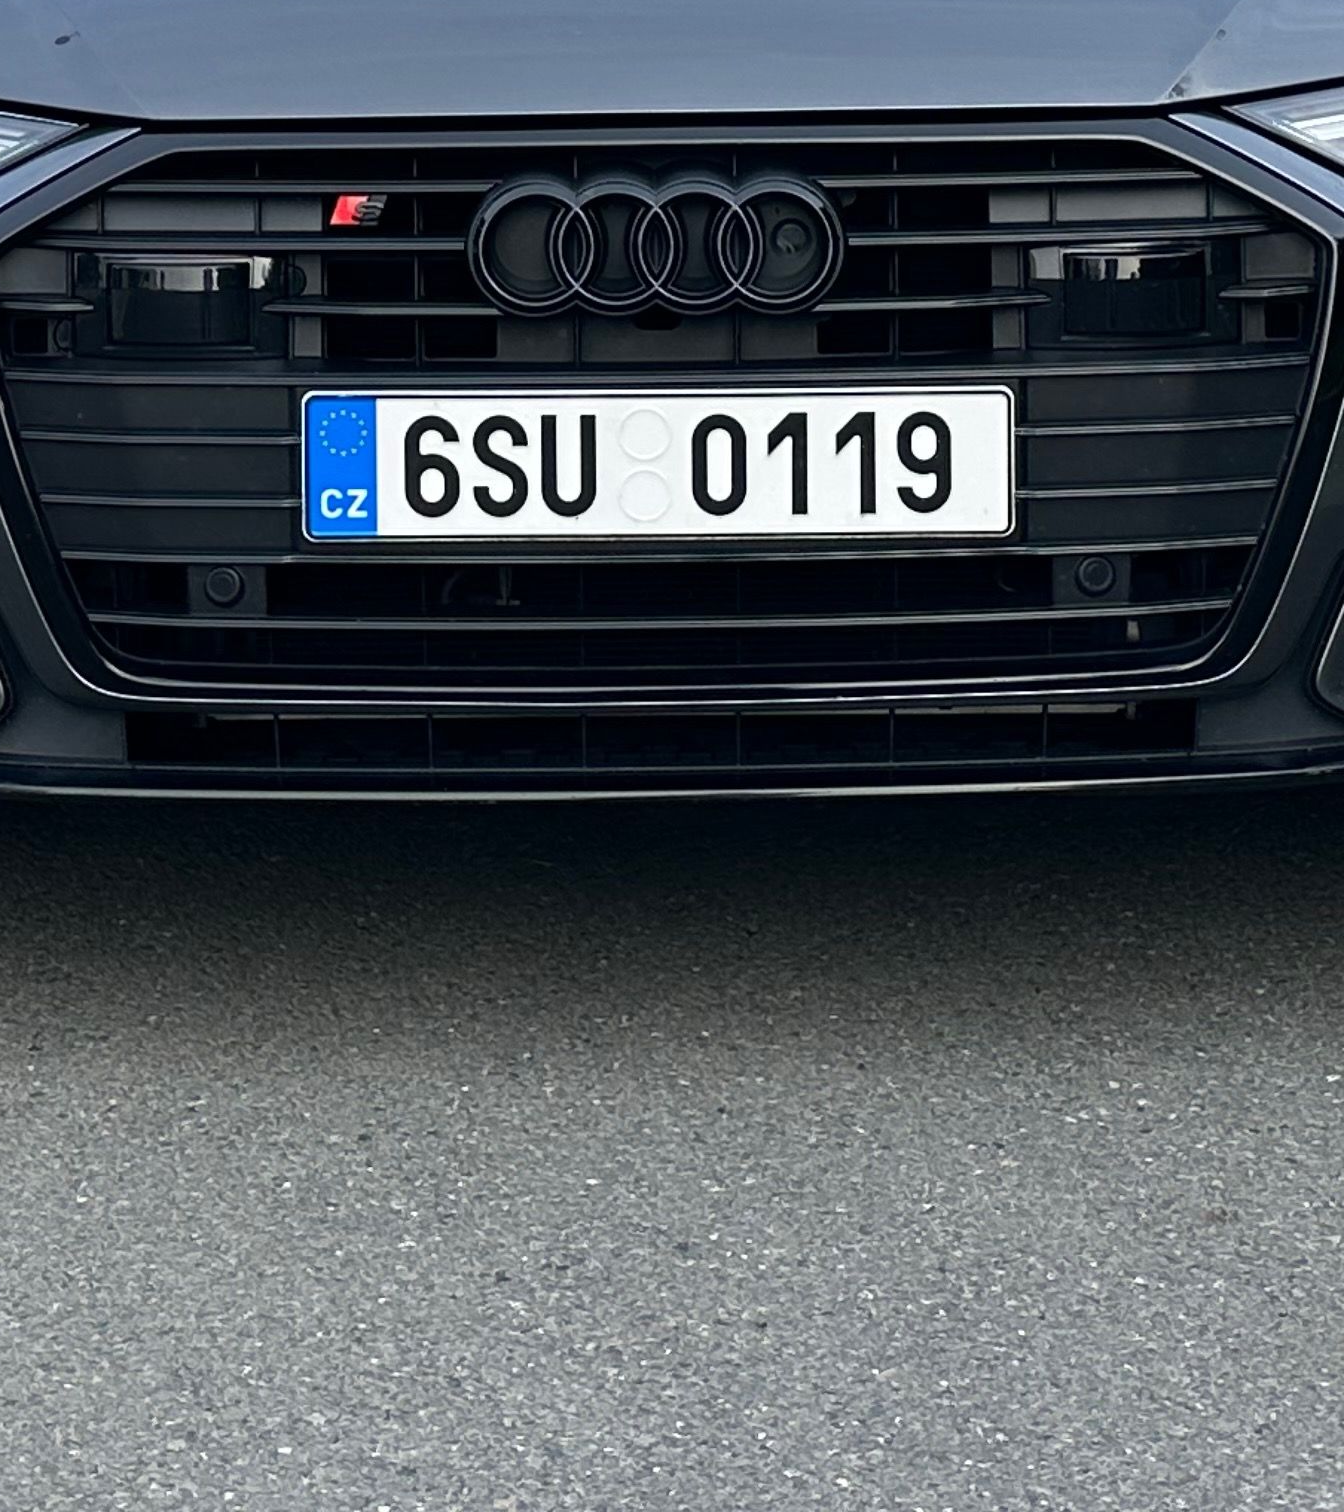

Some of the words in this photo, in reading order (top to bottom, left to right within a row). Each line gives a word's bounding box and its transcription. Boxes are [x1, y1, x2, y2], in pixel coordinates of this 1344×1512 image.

[404, 414, 597, 518] 6SU
[691, 411, 952, 517] 0119
[320, 488, 368, 519] CZ
